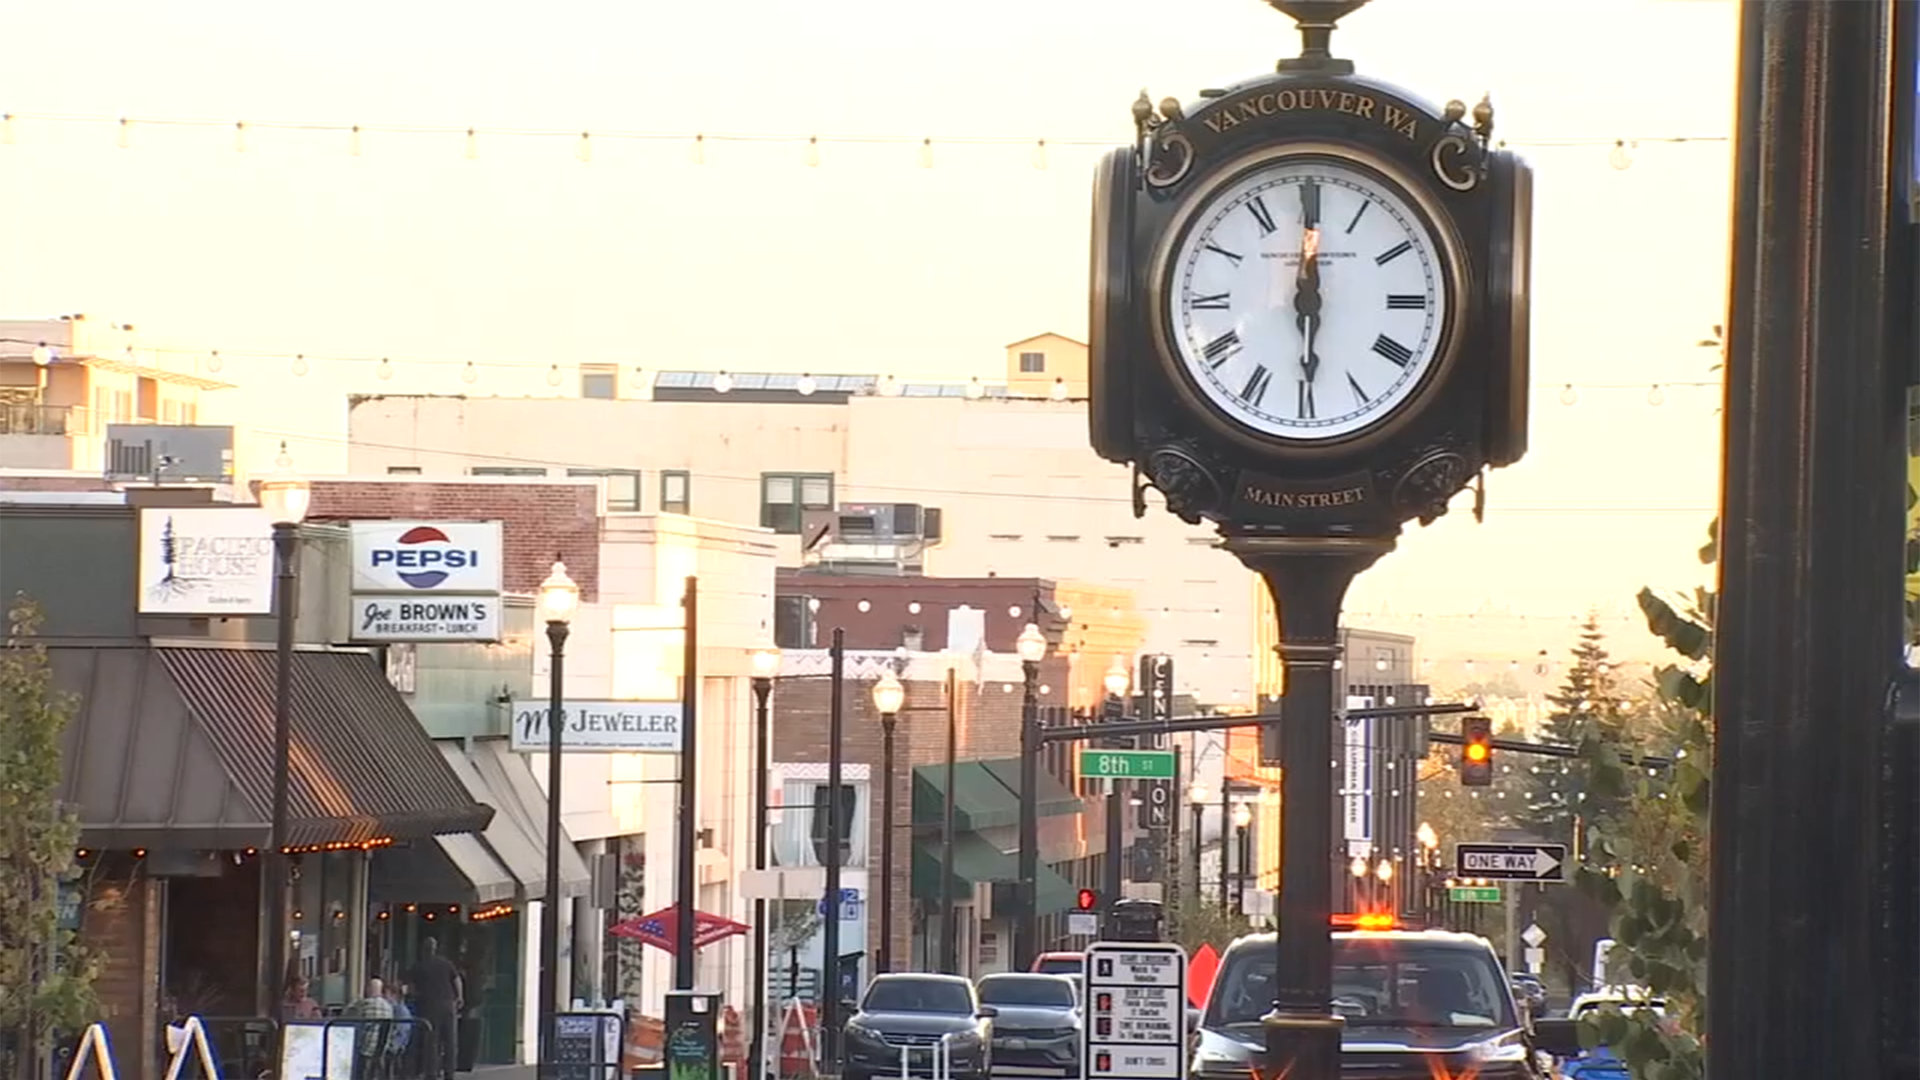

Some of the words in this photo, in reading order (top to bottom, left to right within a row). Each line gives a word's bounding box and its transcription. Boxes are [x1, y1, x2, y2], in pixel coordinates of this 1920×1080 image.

[1204, 89, 1375, 134] VANCOUVER
[1382, 104, 1420, 140] WA
[1385, 294, 1426, 310] III
[1244, 487, 1294, 507] MAIN
[1297, 486, 1365, 508] STREET
[178, 537, 271, 556] PACIFIC
[178, 556, 257, 576] HOUSE
[371, 549, 478, 568] PEPSI
[362, 602, 393, 631] Joe
[400, 602, 487, 621] BROWN'S
[375, 623, 439, 634] BREAKFAST
[446, 623, 479, 634] LUNCH
[571, 709, 678, 734] JEWELER
[1099, 755, 1129, 775] 8th
[1467, 854, 1501, 868] ONE
[1503, 855, 1537, 869] WAY
